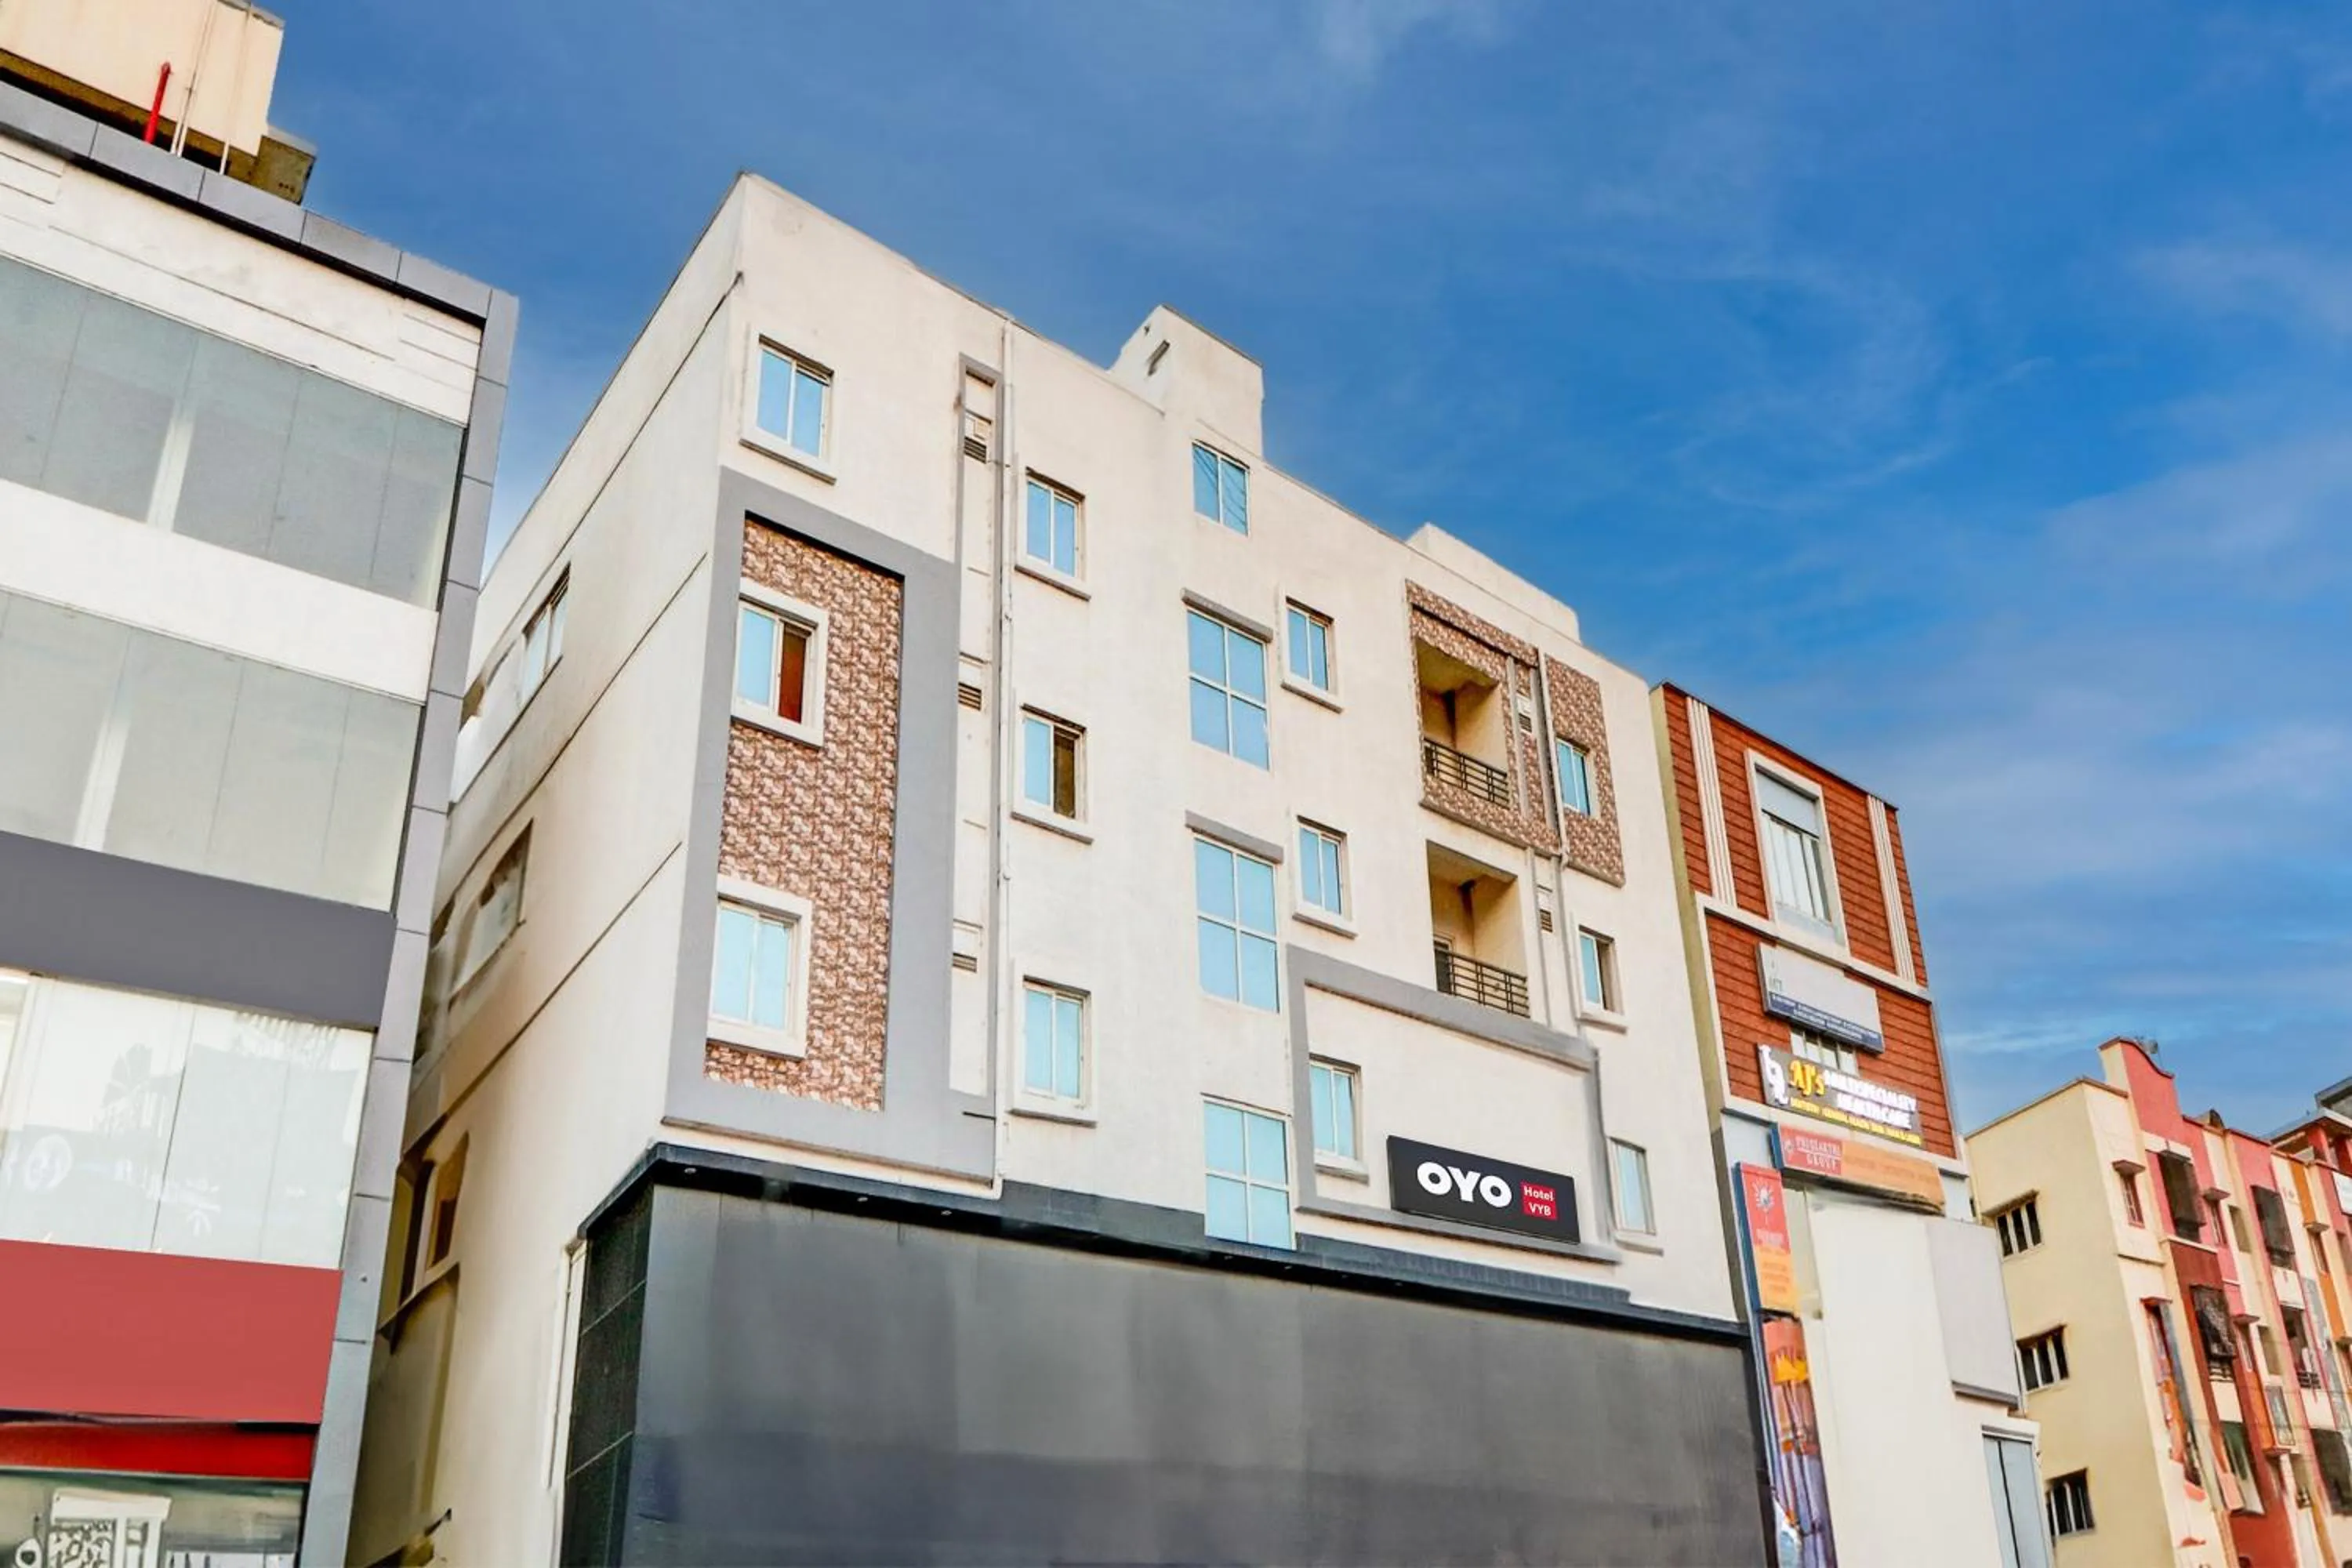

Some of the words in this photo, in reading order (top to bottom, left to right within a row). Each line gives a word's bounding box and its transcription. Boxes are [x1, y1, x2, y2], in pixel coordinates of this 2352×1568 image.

[1788, 1060, 1825, 1096] AJ's
[1417, 1161, 1512, 1208] OYO
[1523, 1185, 1555, 1202] Hotel
[1528, 1202, 1552, 1216] VYB
